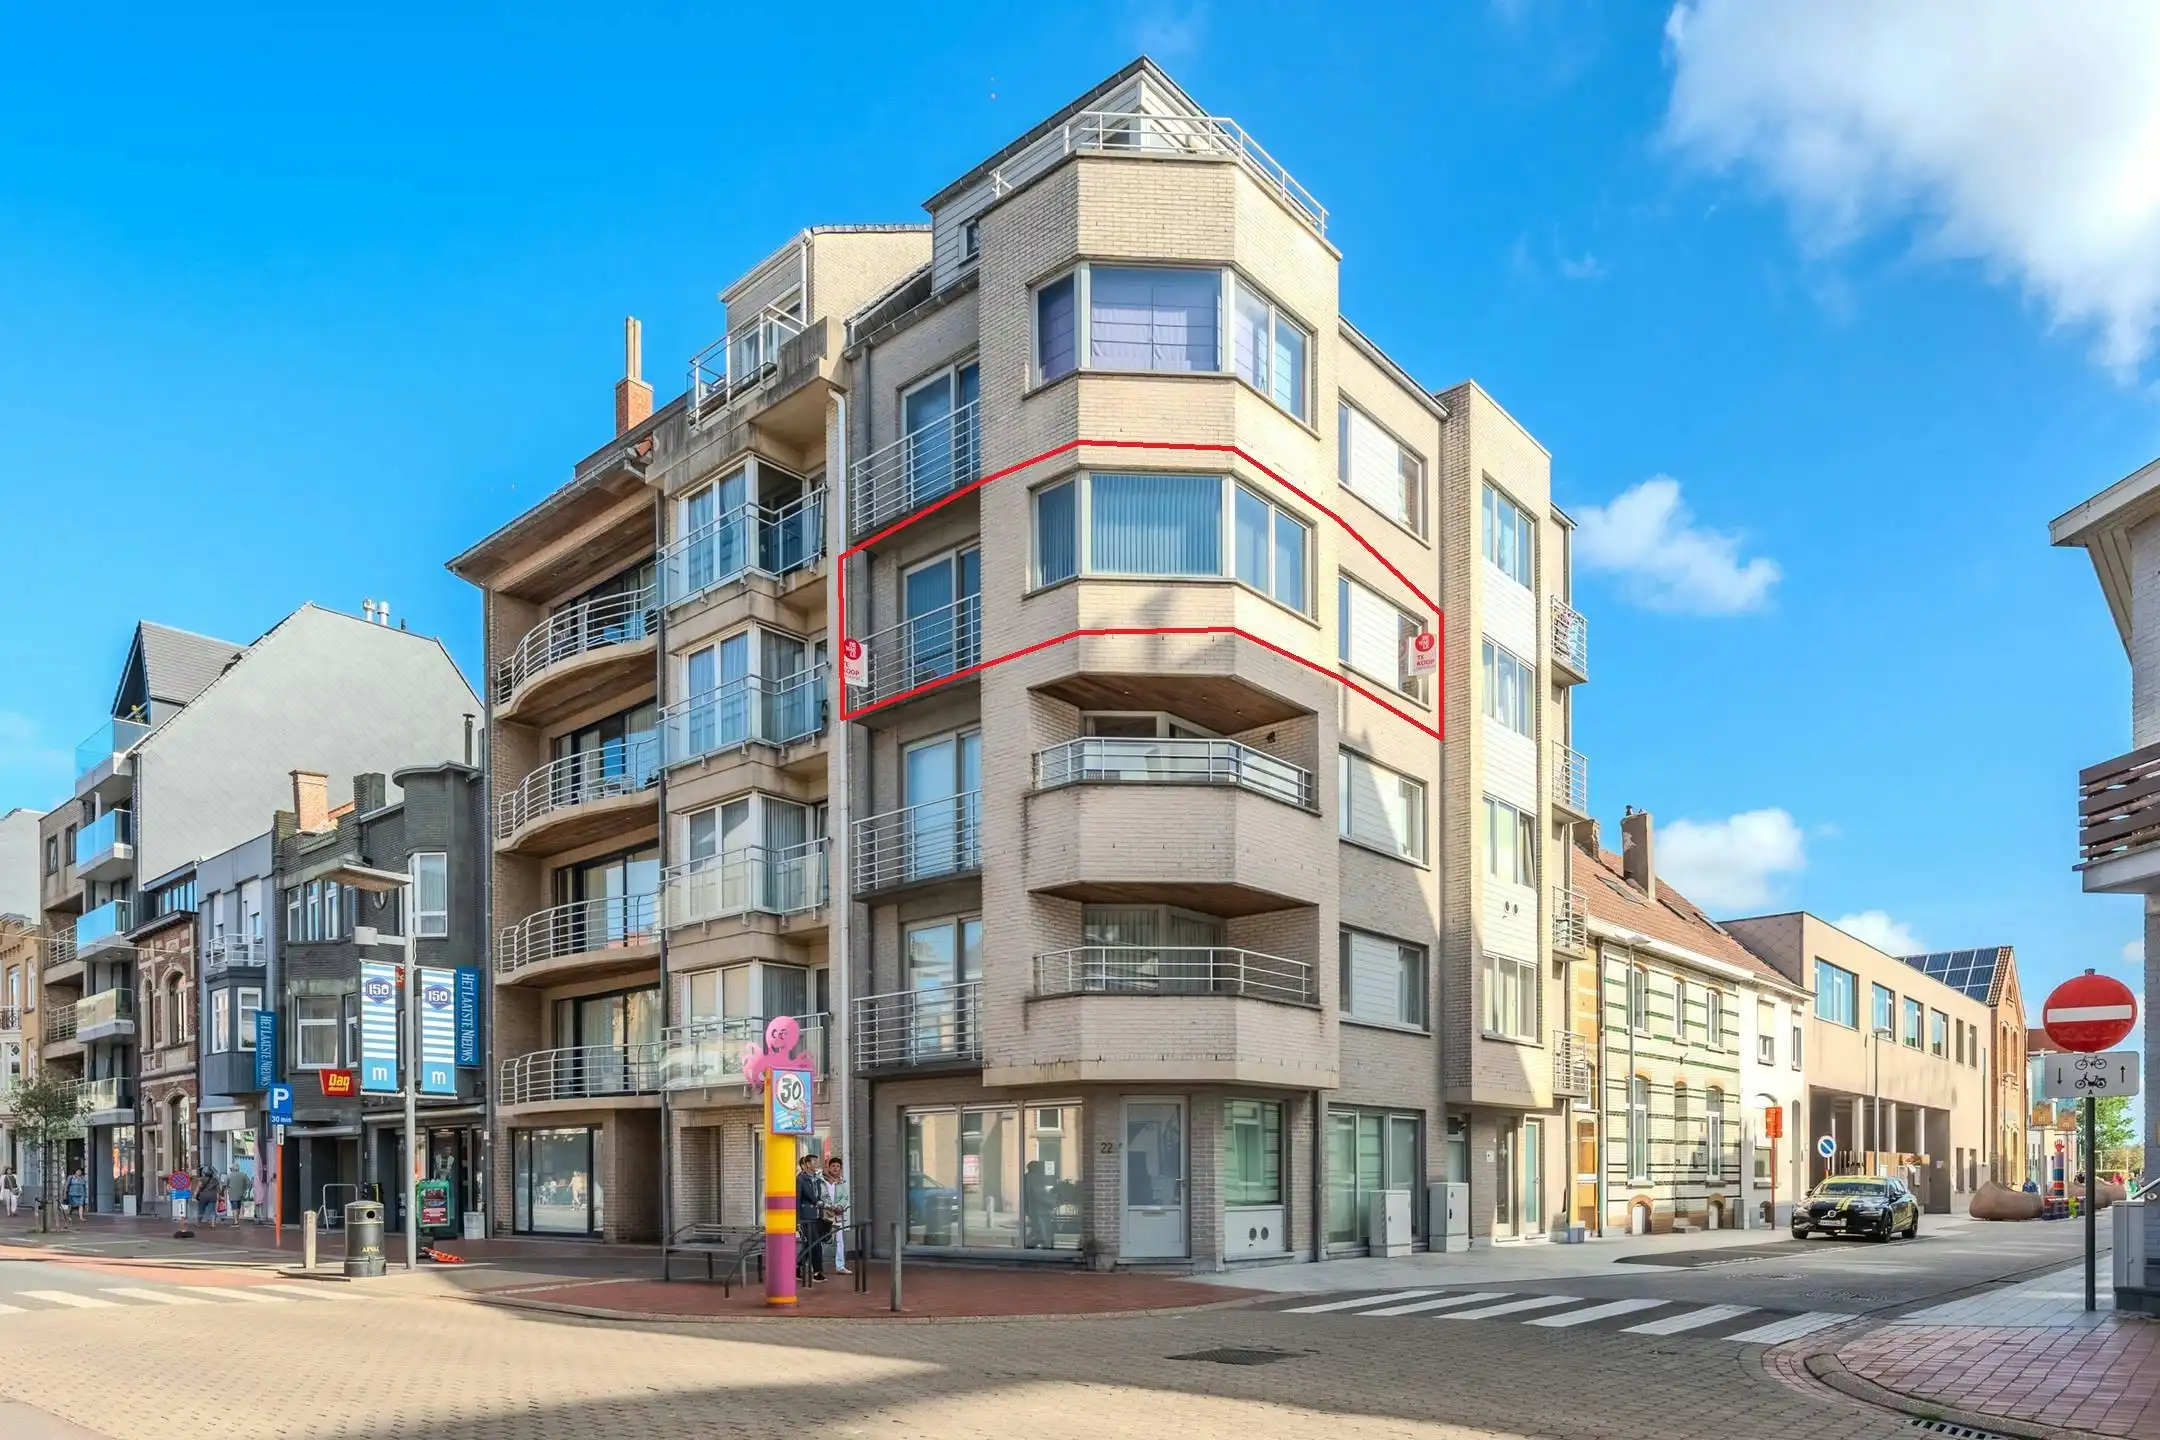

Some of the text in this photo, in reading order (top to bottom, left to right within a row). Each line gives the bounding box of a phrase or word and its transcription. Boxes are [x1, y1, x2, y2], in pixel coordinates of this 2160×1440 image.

[369, 984, 389, 995] 150
[428, 990, 448, 1002] 150
[461, 973, 475, 1062] HET LAATSTE NIEUWS
[260, 1015, 273, 1087] HET LAATSTE NIEUWS
[273, 1088, 289, 1109] P
[780, 1077, 802, 1104] 30
[271, 1115, 279, 1123] 30
[1100, 1142, 1113, 1154] 22
